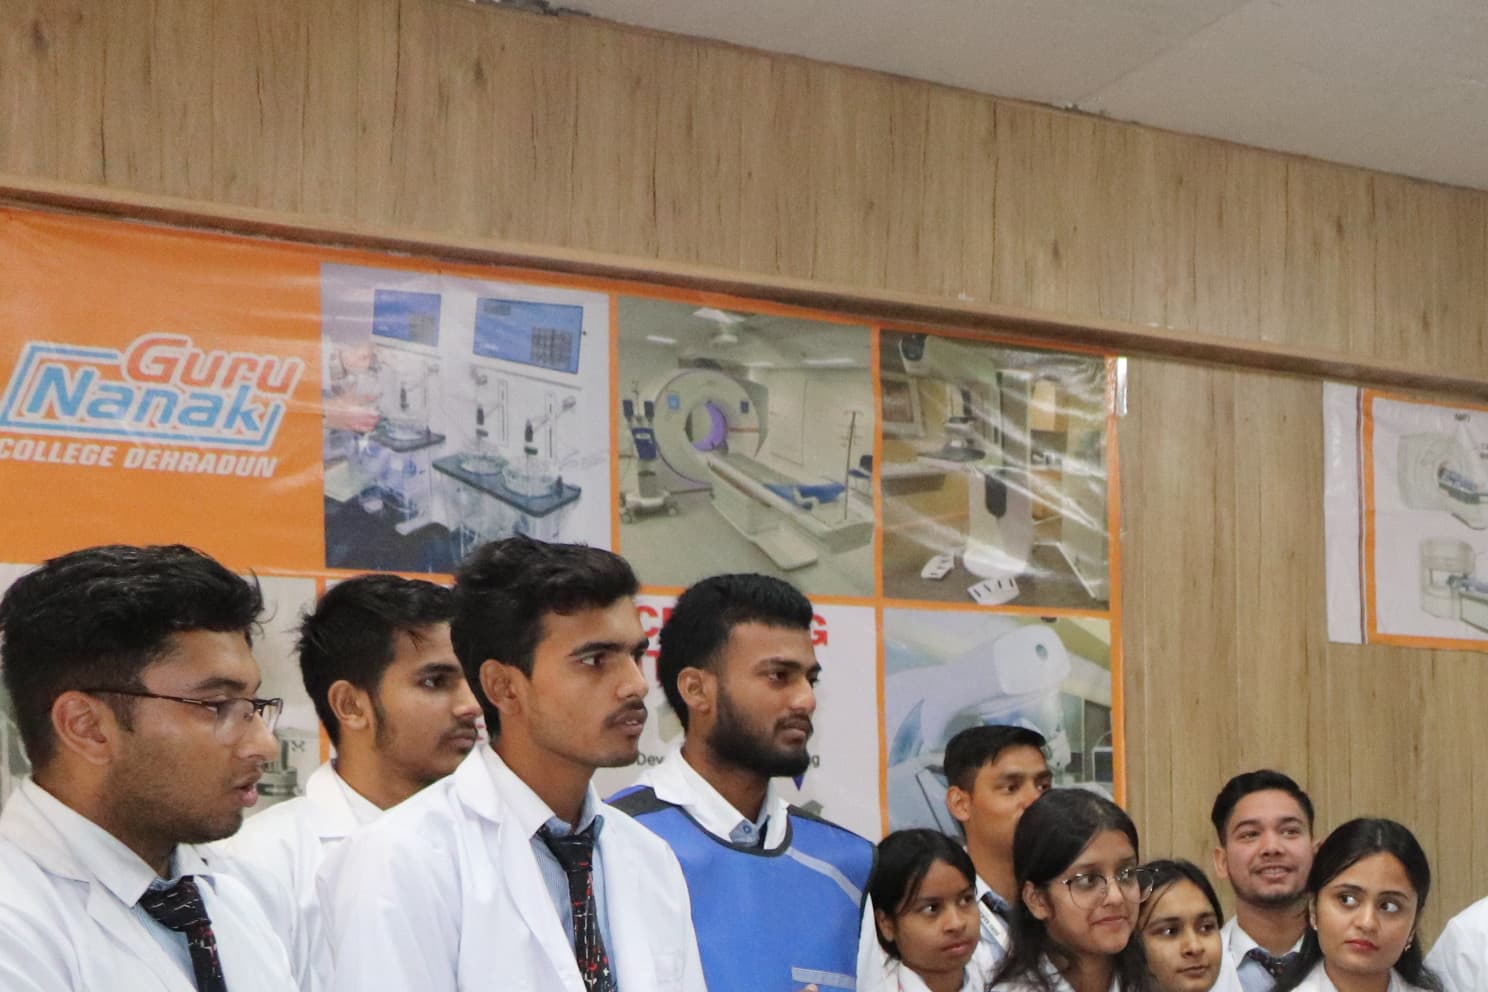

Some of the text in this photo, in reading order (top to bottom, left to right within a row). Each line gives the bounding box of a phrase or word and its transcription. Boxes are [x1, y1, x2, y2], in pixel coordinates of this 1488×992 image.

[126, 334, 299, 394] Guru
[26, 364, 266, 433] Nanak
[0, 437, 279, 478] COLLEGE DEHRADUN
